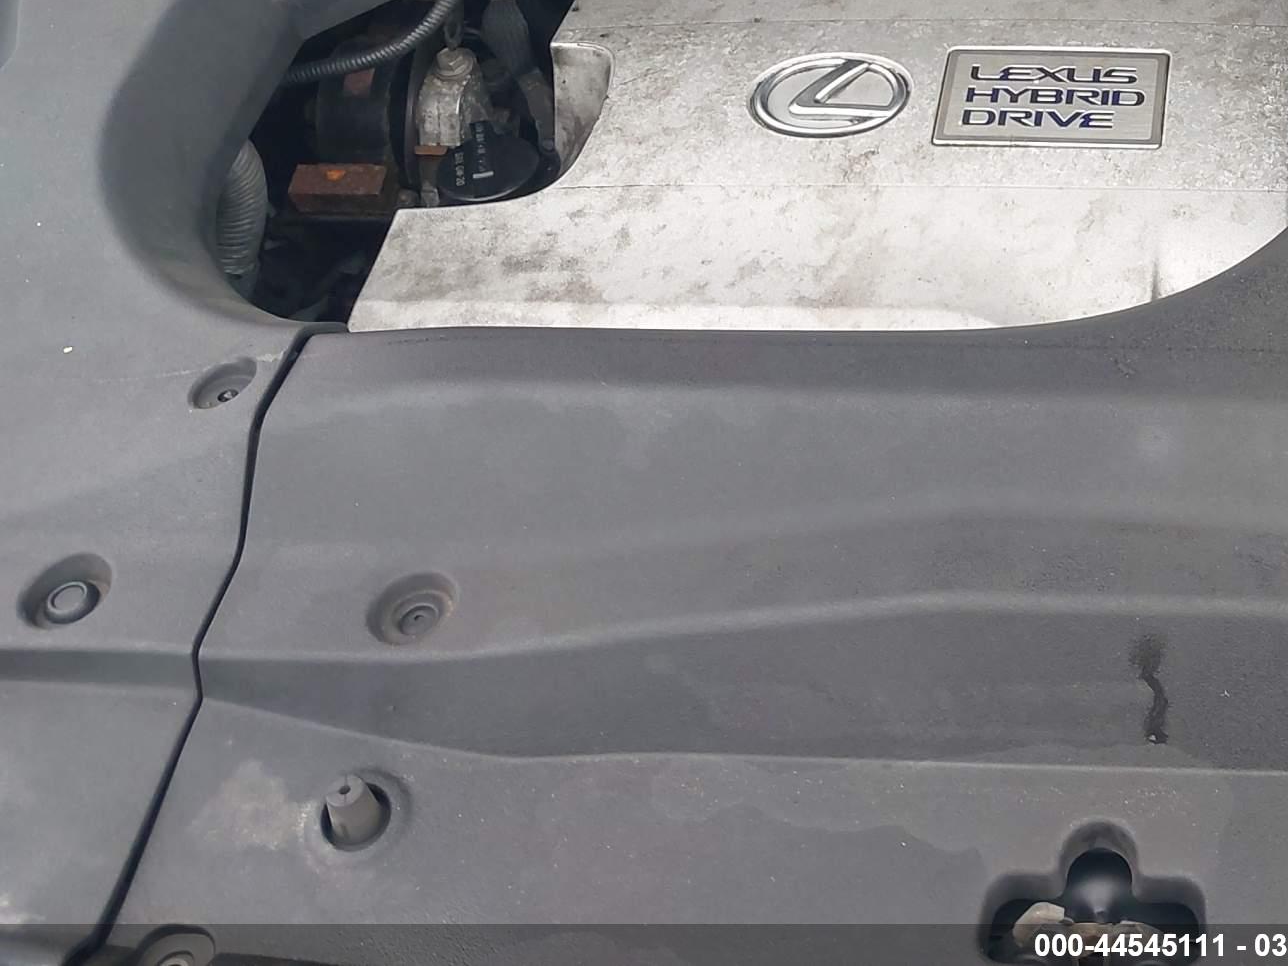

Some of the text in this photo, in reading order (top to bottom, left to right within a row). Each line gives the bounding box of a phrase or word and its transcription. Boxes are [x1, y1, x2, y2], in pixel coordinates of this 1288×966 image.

[970, 65, 1139, 84] LEXUS
[965, 86, 1146, 107] HYBRID
[961, 109, 1116, 129] DRIVE
